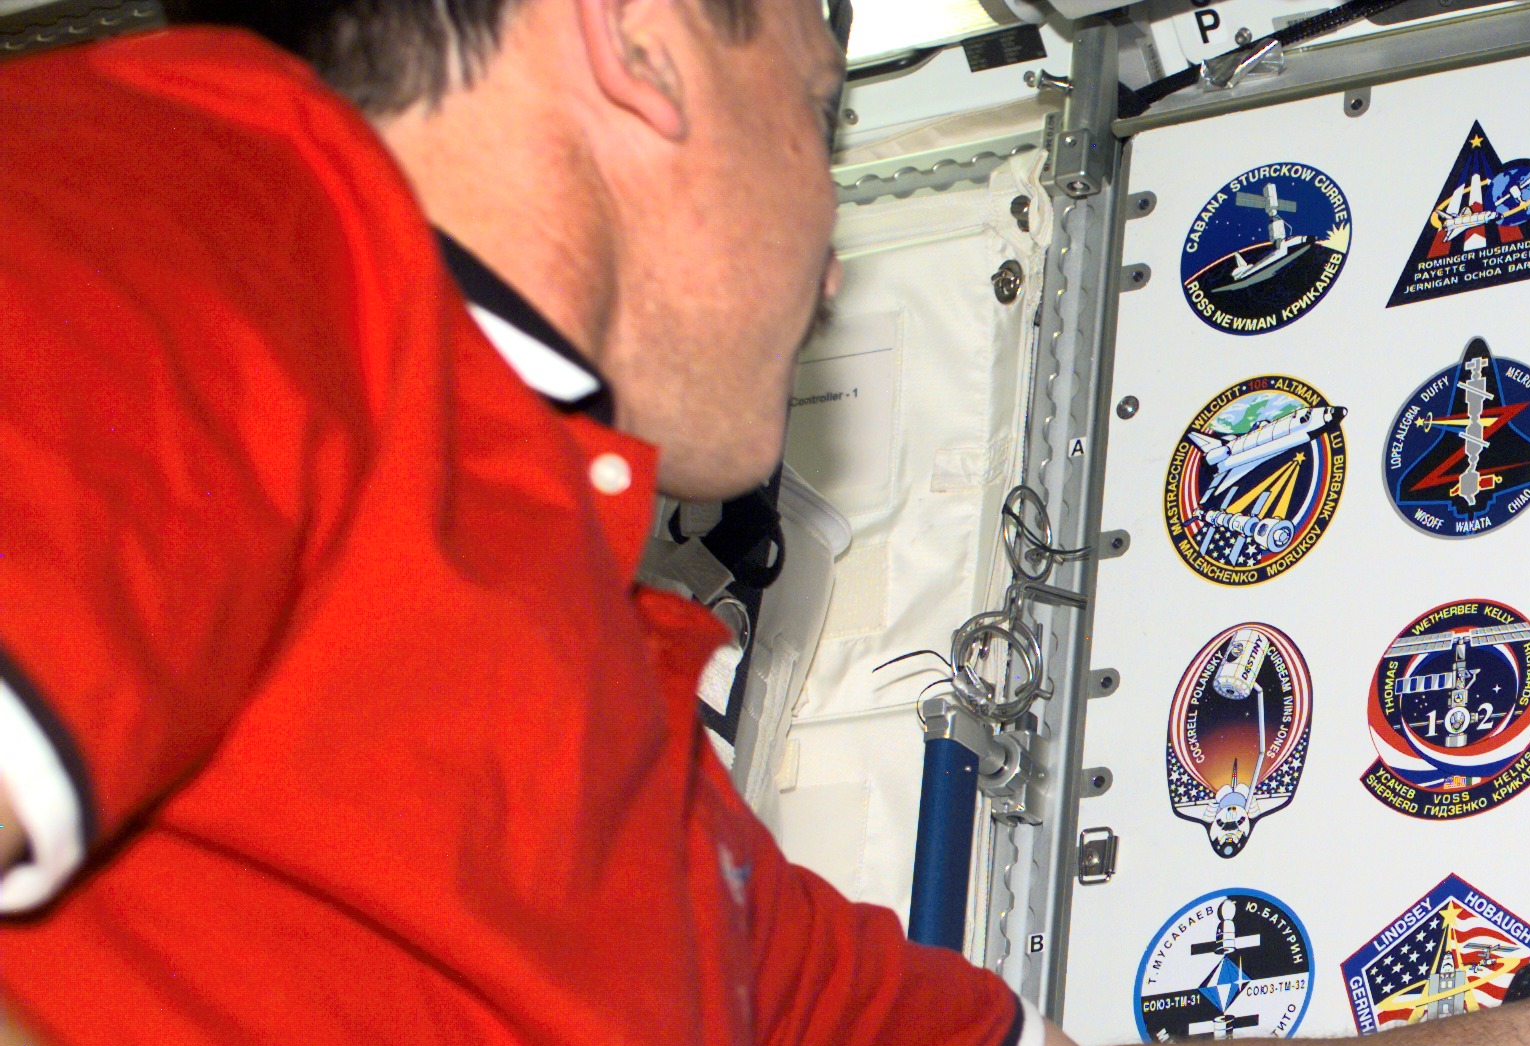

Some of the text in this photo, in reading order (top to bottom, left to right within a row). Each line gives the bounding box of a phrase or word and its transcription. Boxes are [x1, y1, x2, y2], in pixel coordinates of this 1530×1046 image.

[1194, 8, 1220, 44] P
[1186, 163, 1348, 254] CABANA STURCKOW CURRIE
[1403, 276, 1458, 294] JERNIGAN
[1464, 267, 1502, 282] OCHOA
[1414, 264, 1466, 282] PAYETTE
[1417, 252, 1476, 272] ROMINGER
[1186, 280, 1214, 318] ROSS
[1212, 309, 1278, 330] NEWMAN
[1191, 378, 1320, 430] WILCUTT 106 ALTMAN
[1390, 375, 1450, 470] LOPEZ-ALEGRIA DUFFY
[1070, 439, 1086, 458] A
[1318, 431, 1344, 520] LU BURBANK
[1167, 441, 1322, 584] MASTRACCHIO MALENCHENKO MORUKOV
[1413, 508, 1444, 530] WISOFF
[1455, 516, 1492, 532] WAKATA
[1385, 660, 1400, 716] THOMAS
[1411, 603, 1480, 636] WETHERBEE
[1483, 605, 1514, 624] KELLY
[1186, 650, 1224, 764] COCKRELL POLANSKY
[1266, 646, 1294, 760] CURBEAM IVINS JONES
[1366, 774, 1418, 814] SHEPHERD
[1423, 797, 1488, 818] ГИДЗЕНКО
[1377, 767, 1416, 800] УСАЧЕВ
[1433, 792, 1470, 804] VOSS
[1030, 935, 1046, 954] B
[1245, 901, 1304, 964] Ю.БАТУРИН
[1373, 897, 1434, 952] LINDSEY
